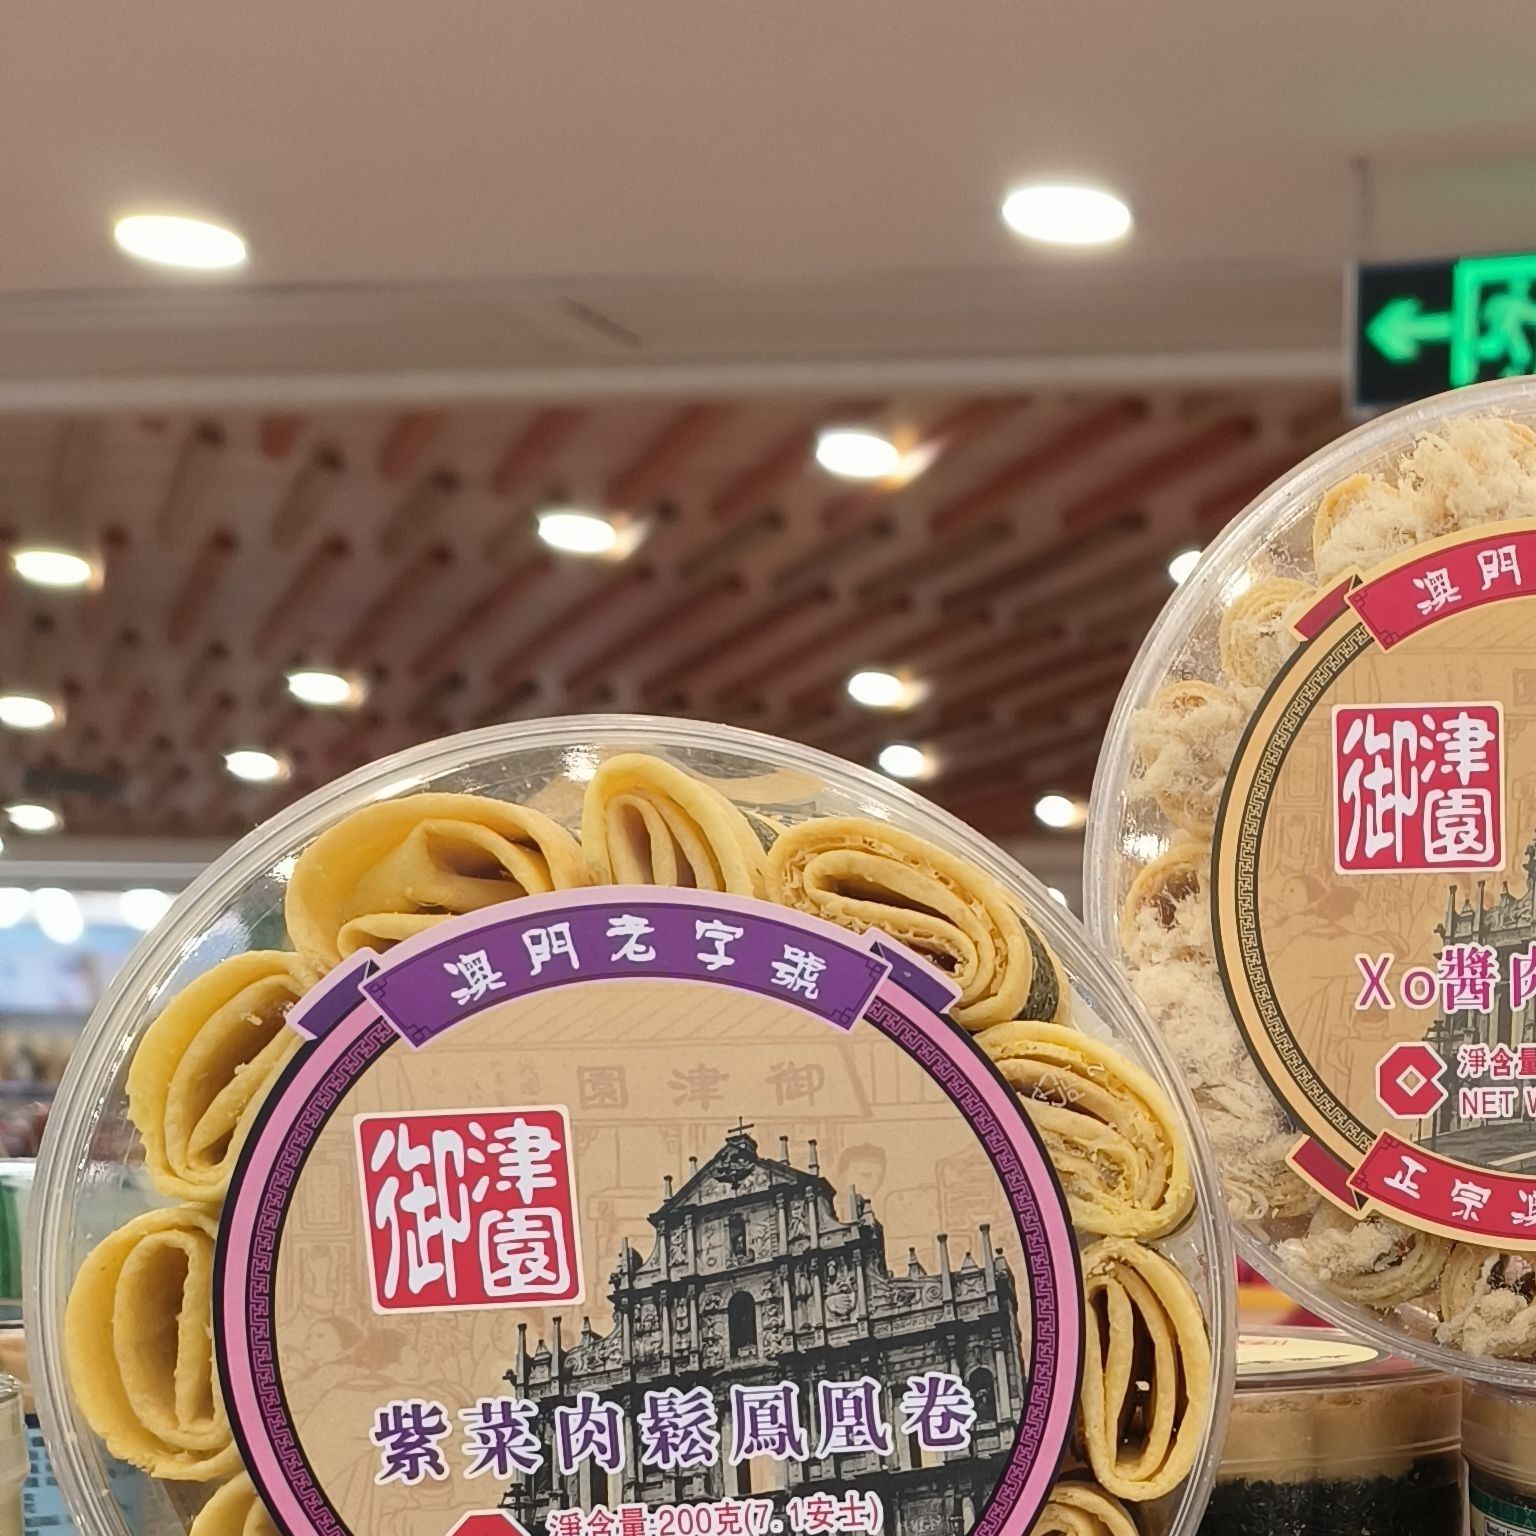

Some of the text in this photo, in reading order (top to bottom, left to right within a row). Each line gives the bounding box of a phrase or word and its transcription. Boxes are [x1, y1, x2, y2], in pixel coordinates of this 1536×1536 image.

[443, 912, 828, 1004] 澳門老字號
[1458, 1088, 1514, 1120] NET
[369, 1374, 979, 1488] 紫菜肉鬆鳳凰卷
